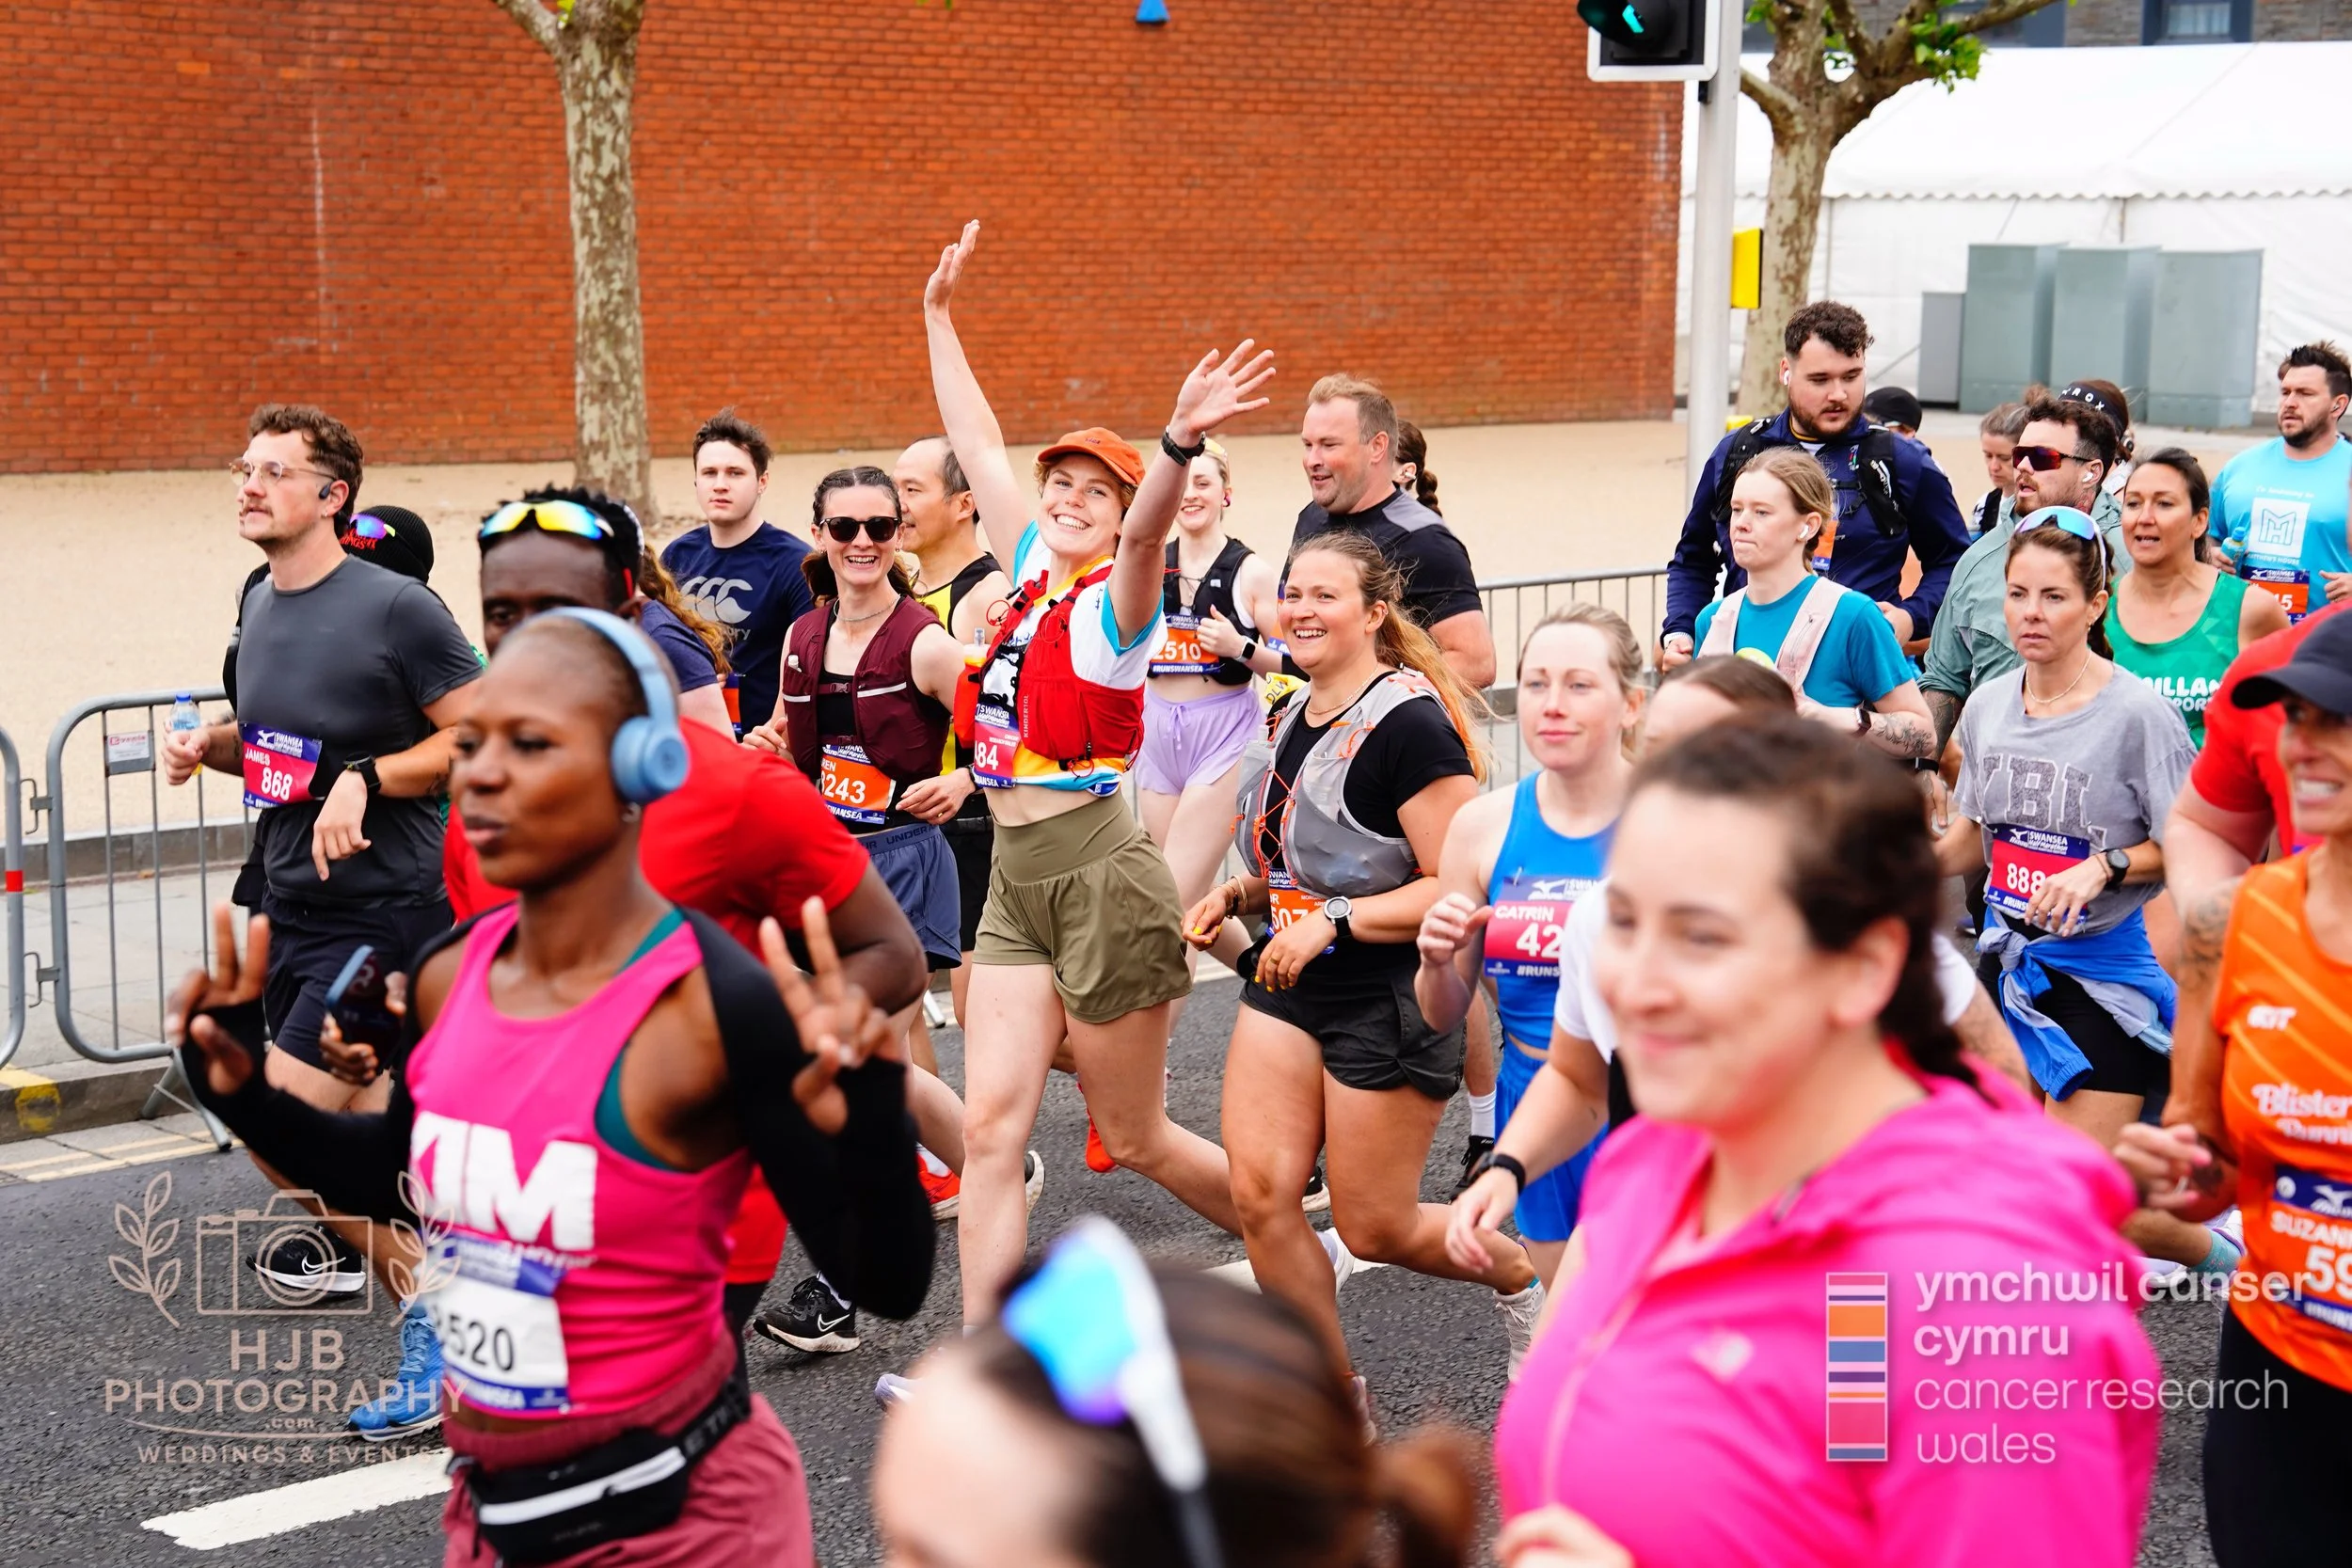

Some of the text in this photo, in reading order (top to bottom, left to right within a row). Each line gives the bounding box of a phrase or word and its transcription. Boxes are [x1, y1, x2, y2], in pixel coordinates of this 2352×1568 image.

[1152, 664, 1204, 673] #RUNSWANSEA
[979, 705, 1010, 720] SWANSEA
[275, 732, 304, 749] SWANSEA
[245, 748, 271, 767] JAMES
[261, 766, 294, 800] 868
[886, 826, 928, 845] UNDER
[2029, 831, 2068, 846] SWANSEA
[2007, 863, 2047, 895] 888
[1494, 905, 1555, 923] CATRIN
[1516, 922, 1564, 958] 42
[2305, 1243, 2352, 1300] 59
